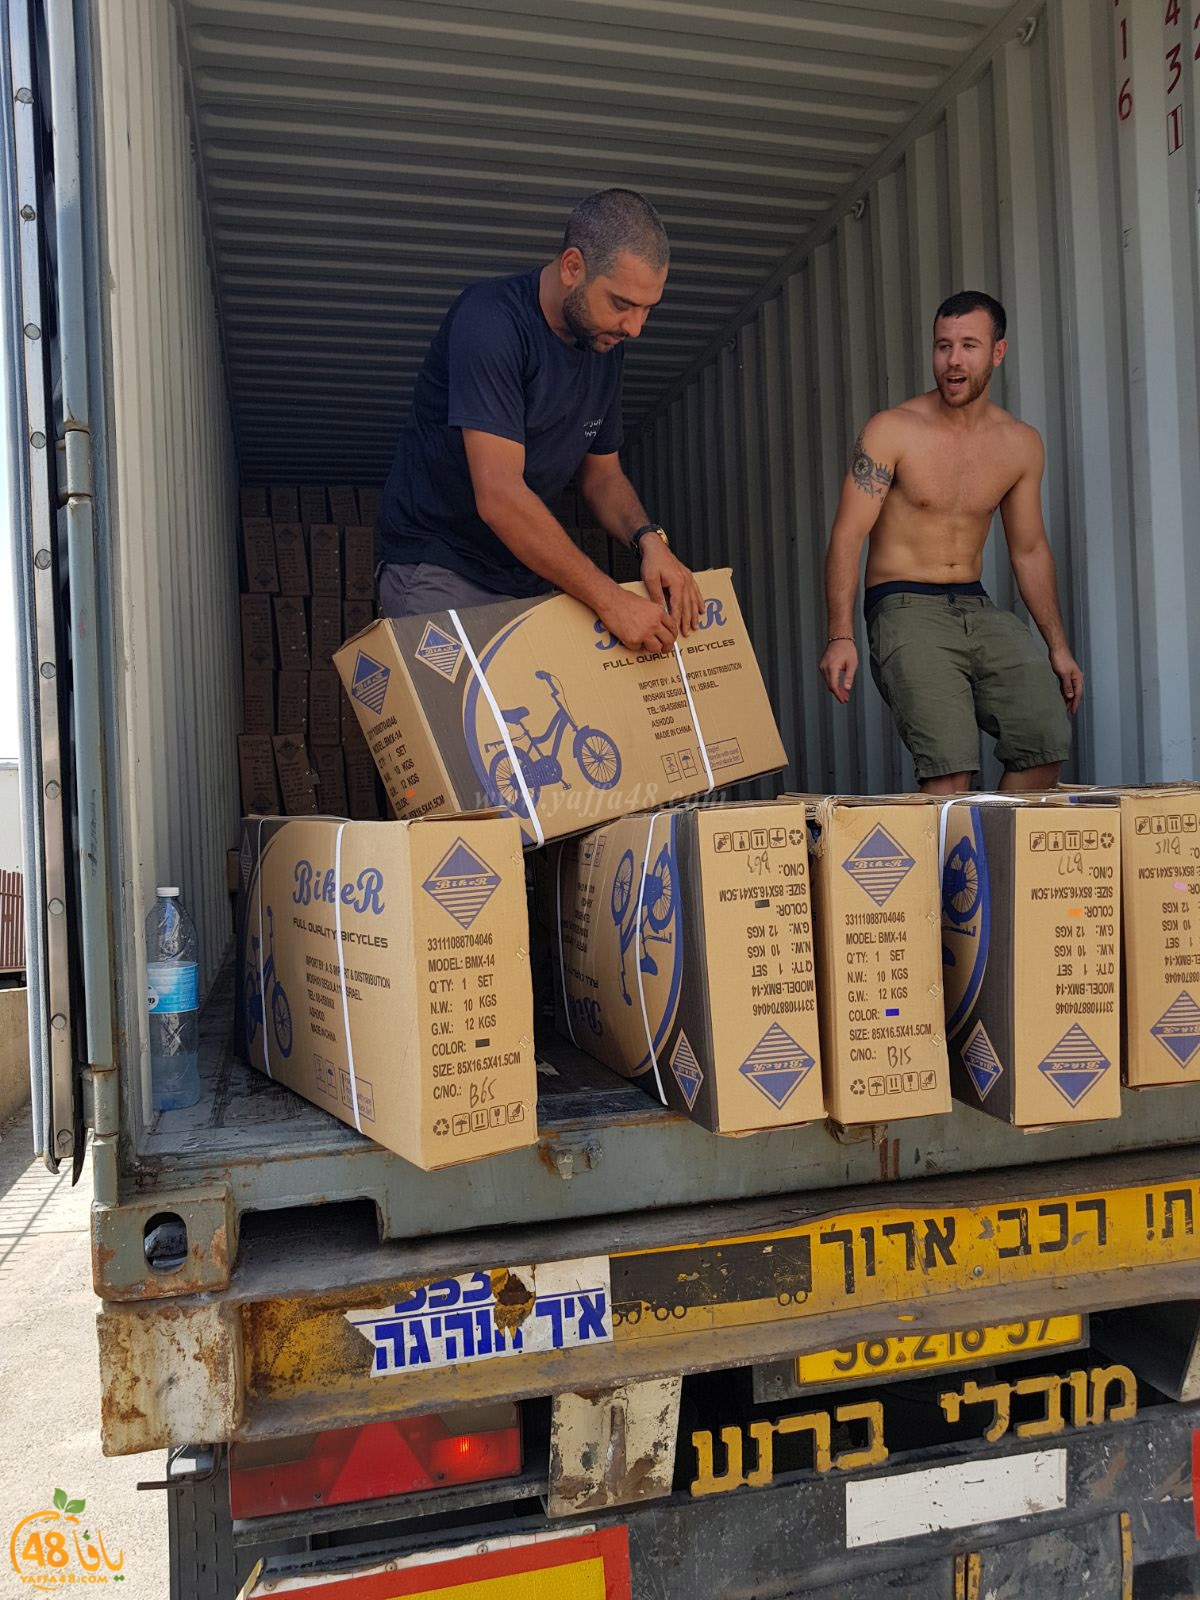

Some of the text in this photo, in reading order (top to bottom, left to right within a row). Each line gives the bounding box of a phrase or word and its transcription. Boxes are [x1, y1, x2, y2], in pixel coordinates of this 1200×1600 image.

[602, 658, 635, 671] FULL
[686, 638, 736, 654] BICYCLES
[638, 679, 660, 690] IMPORT
[660, 678, 671, 687] BY:
[707, 662, 743, 676] DISTRIBUTION
[643, 690, 667, 702] MOSHAV
[666, 687, 687, 699] SEGUL
[647, 705, 660, 715] TEL:
[651, 715, 675, 728] ASHDOD
[654, 730, 671, 741] MADE
[675, 724, 692, 735] CHINA
[395, 743, 408, 758] SET
[401, 758, 415, 772] KGS
[407, 772, 420, 787] KGS
[778, 863, 805, 877] C/NO.:
[1088, 866, 1113, 879] C/NO.:
[1138, 865, 1195, 880] 85X16.5X41.5CM
[292, 859, 386, 916] BikeR
[719, 883, 807, 902] SIZE: 85X16.5X41.5CM
[1031, 886, 1113, 900] SIZE: 85X16.5X41.5CM
[776, 902, 808, 916] COLOR:
[1084, 905, 1113, 918] COLOR:
[1161, 901, 1190, 914] 12 KGS
[845, 912, 906, 926] 33111088704046
[1161, 919, 1192, 932] 10 KGS
[293, 917, 389, 949] FULL QUALITY BICYCLES
[746, 921, 810, 939] G.W.: 12 KGS
[878, 931, 907, 944] BMX-14
[1055, 924, 1114, 938] G.W.: 12 KGS
[427, 933, 493, 952] 33111088704046
[747, 941, 812, 958] N.W.: 10 KGS
[1165, 937, 1180, 949] SET
[890, 949, 905, 961] SET
[1054, 944, 1114, 957] N.W.: 10 KGS
[465, 954, 496, 970] BMX-14
[1056, 963, 1073, 976] SET
[751, 964, 768, 977] SET
[847, 968, 909, 983] N.W.: 10 KGS
[354, 970, 391, 990] DISTRIBUTION
[477, 974, 494, 988] SET
[848, 987, 908, 1003] G.W.: 12 KGS
[430, 993, 497, 1015] N.W.: 10 KGS
[752, 999, 815, 1016] 33111088704046
[1055, 1001, 1114, 1015] 33111088704046
[848, 1008, 880, 1022] COLOR:
[431, 1014, 497, 1036] G.W.: 12 KGS
[849, 1023, 932, 1041] SIZE: 85X16.5X41.5CM
[432, 1040, 467, 1057] COLOR:
[850, 1048, 877, 1061] C/NO.:
[432, 1051, 521, 1078] SIZE: 85X16.5X41.5CM
[433, 1083, 462, 1100] C/NO.:
[997, 1198, 1107, 1260] רכב
[819, 1216, 958, 1294] ארוך
[938, 1364, 1139, 1443] מובלי
